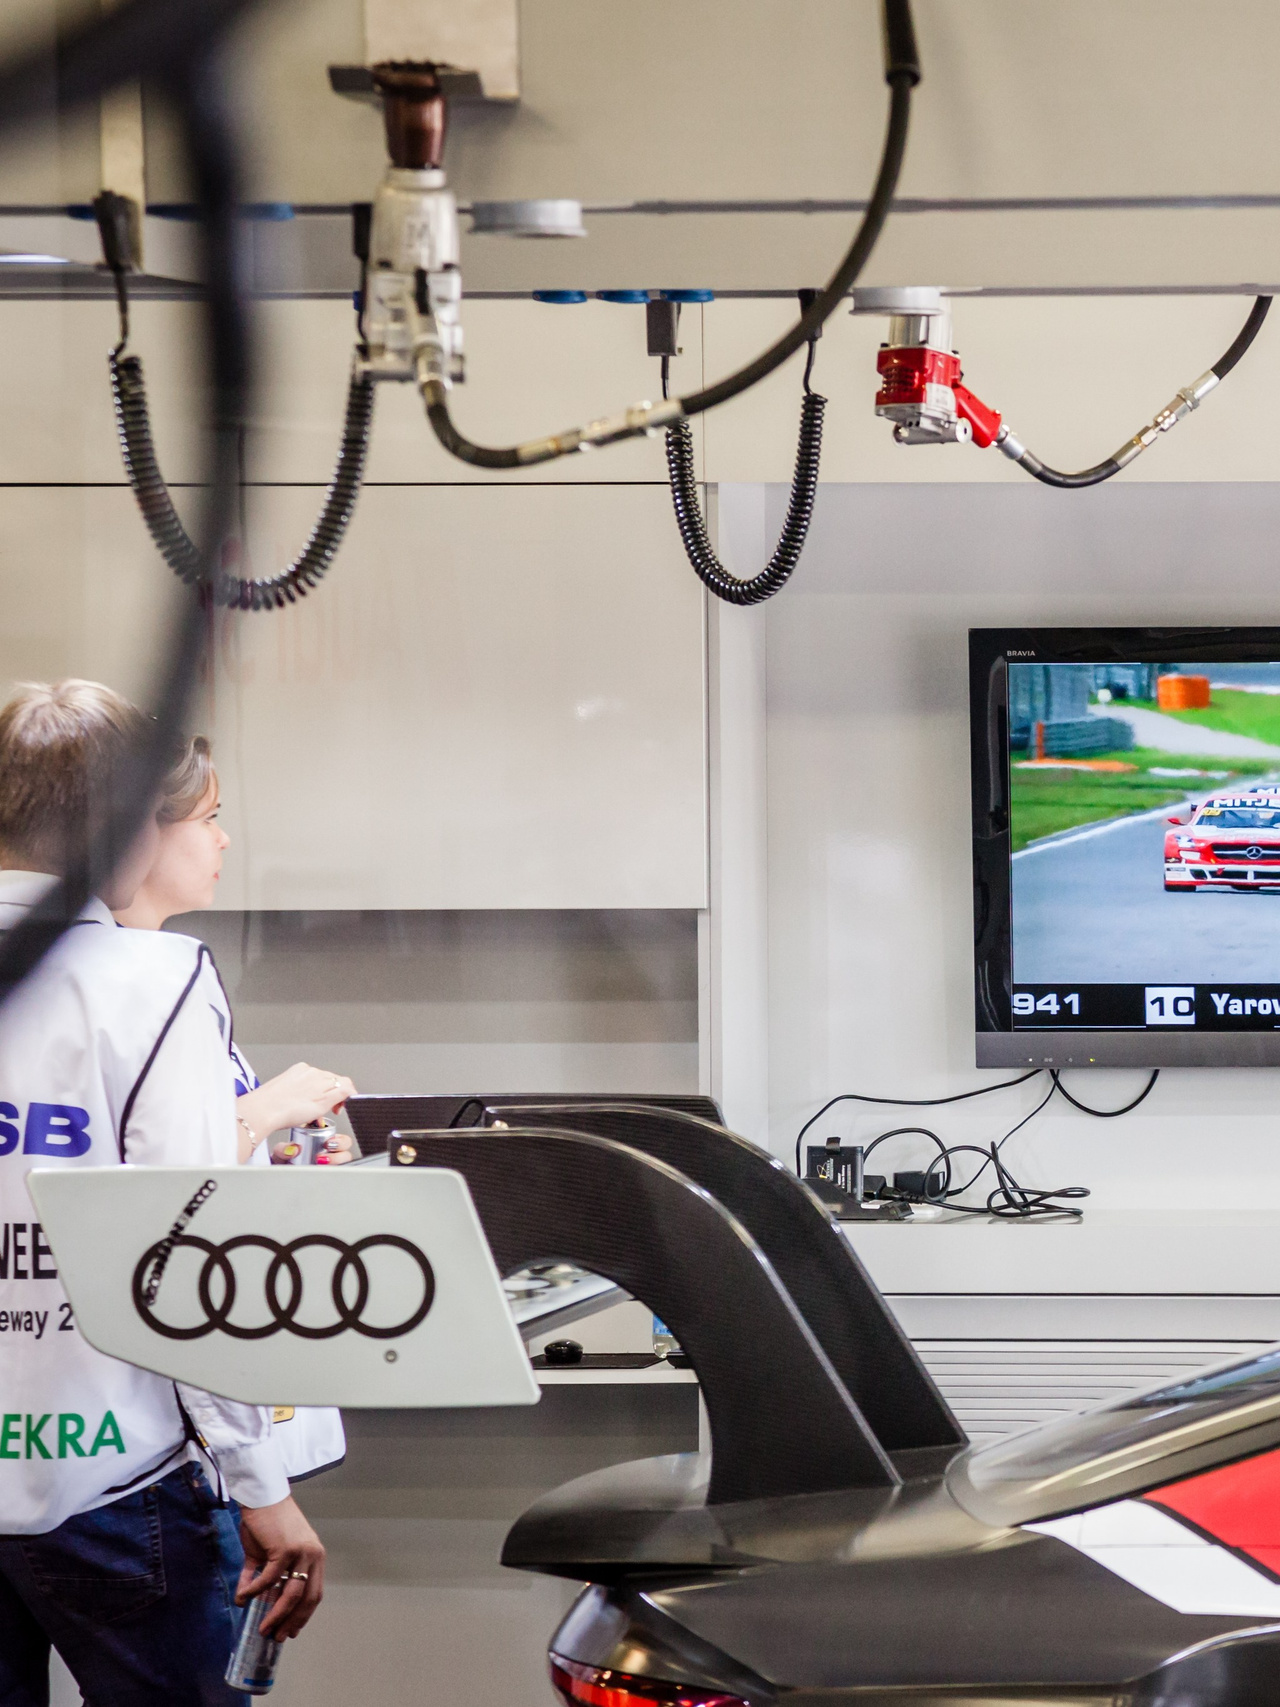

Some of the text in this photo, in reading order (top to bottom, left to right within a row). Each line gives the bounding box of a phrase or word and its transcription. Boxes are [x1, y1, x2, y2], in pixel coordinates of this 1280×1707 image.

[1013, 993, 1080, 1015] 941
[1150, 997, 1195, 1016] 10
[0, 1410, 127, 1459] EKRA
